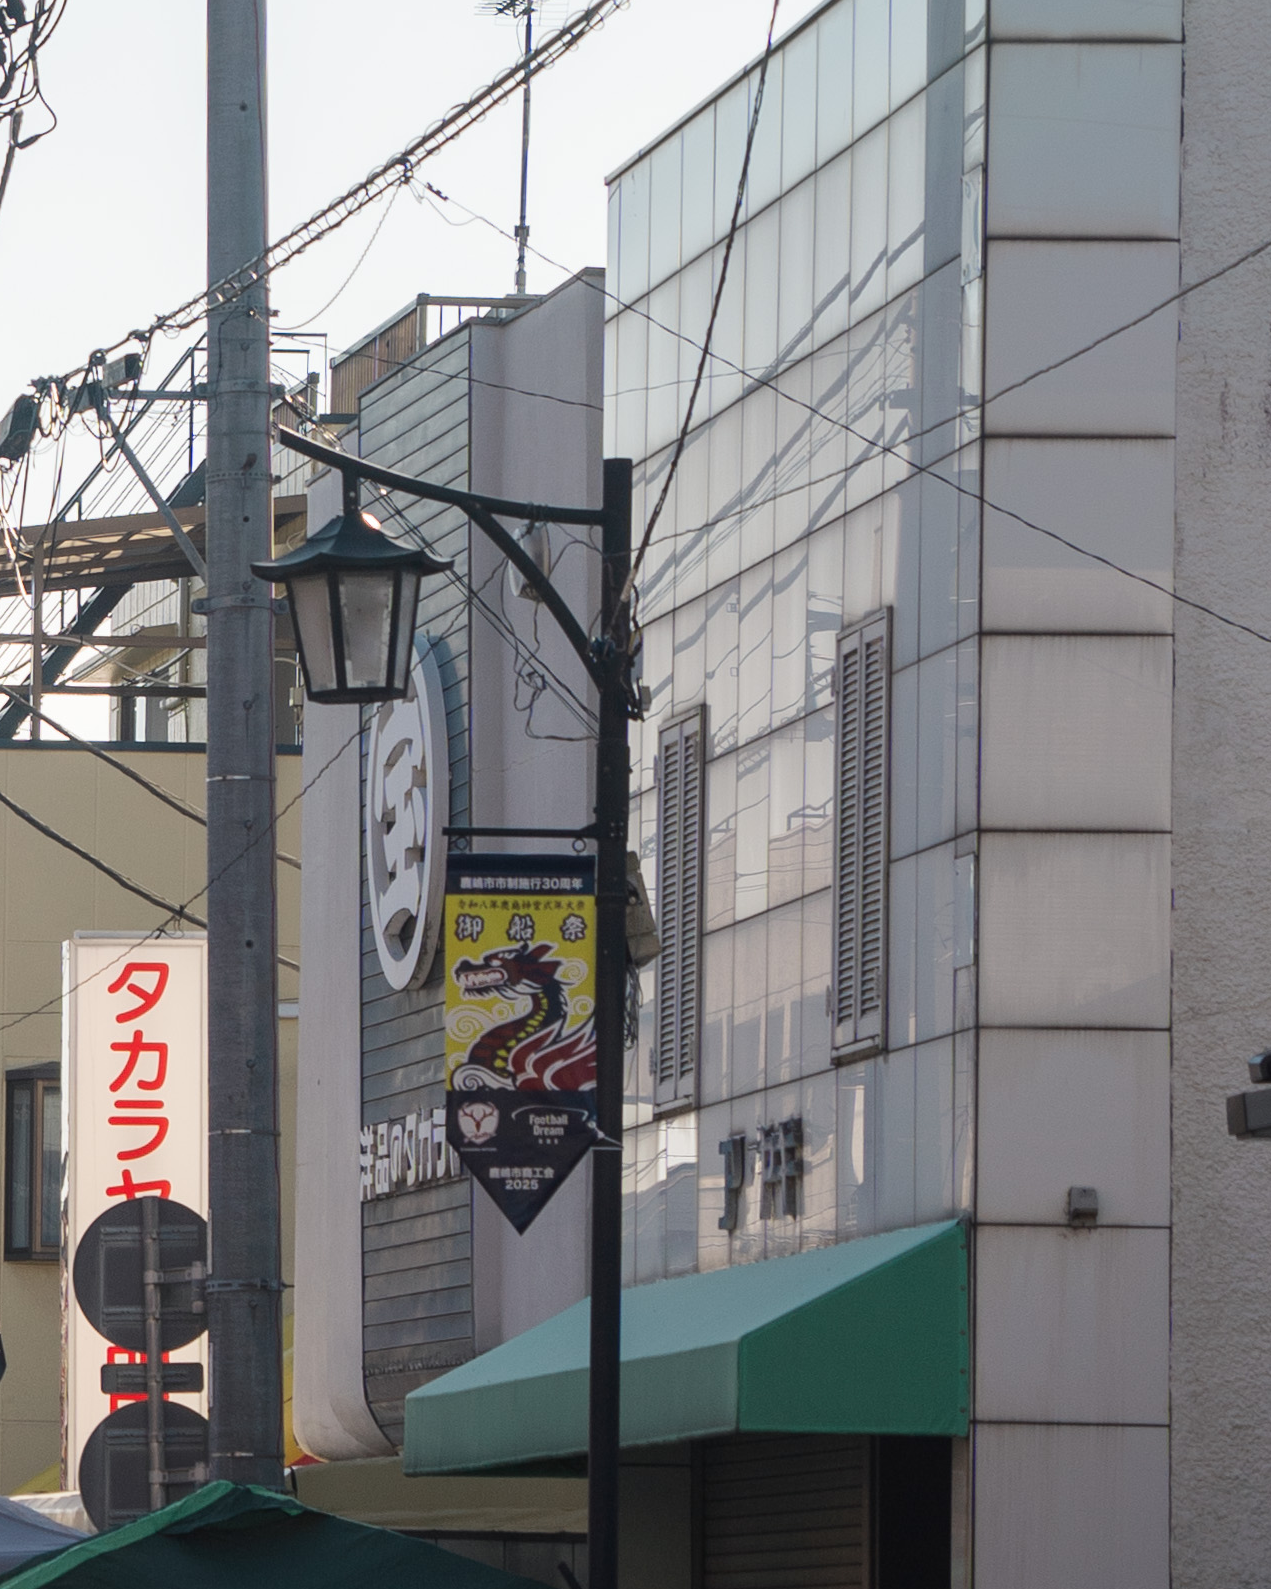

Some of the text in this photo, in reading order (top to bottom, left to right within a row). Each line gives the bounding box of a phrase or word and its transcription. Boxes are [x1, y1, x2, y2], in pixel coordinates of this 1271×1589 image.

[455, 913, 587, 943] 御船祭
[528, 1114, 569, 1126] Football
[532, 1125, 565, 1137] Dream
[504, 1179, 540, 1191] 2025
